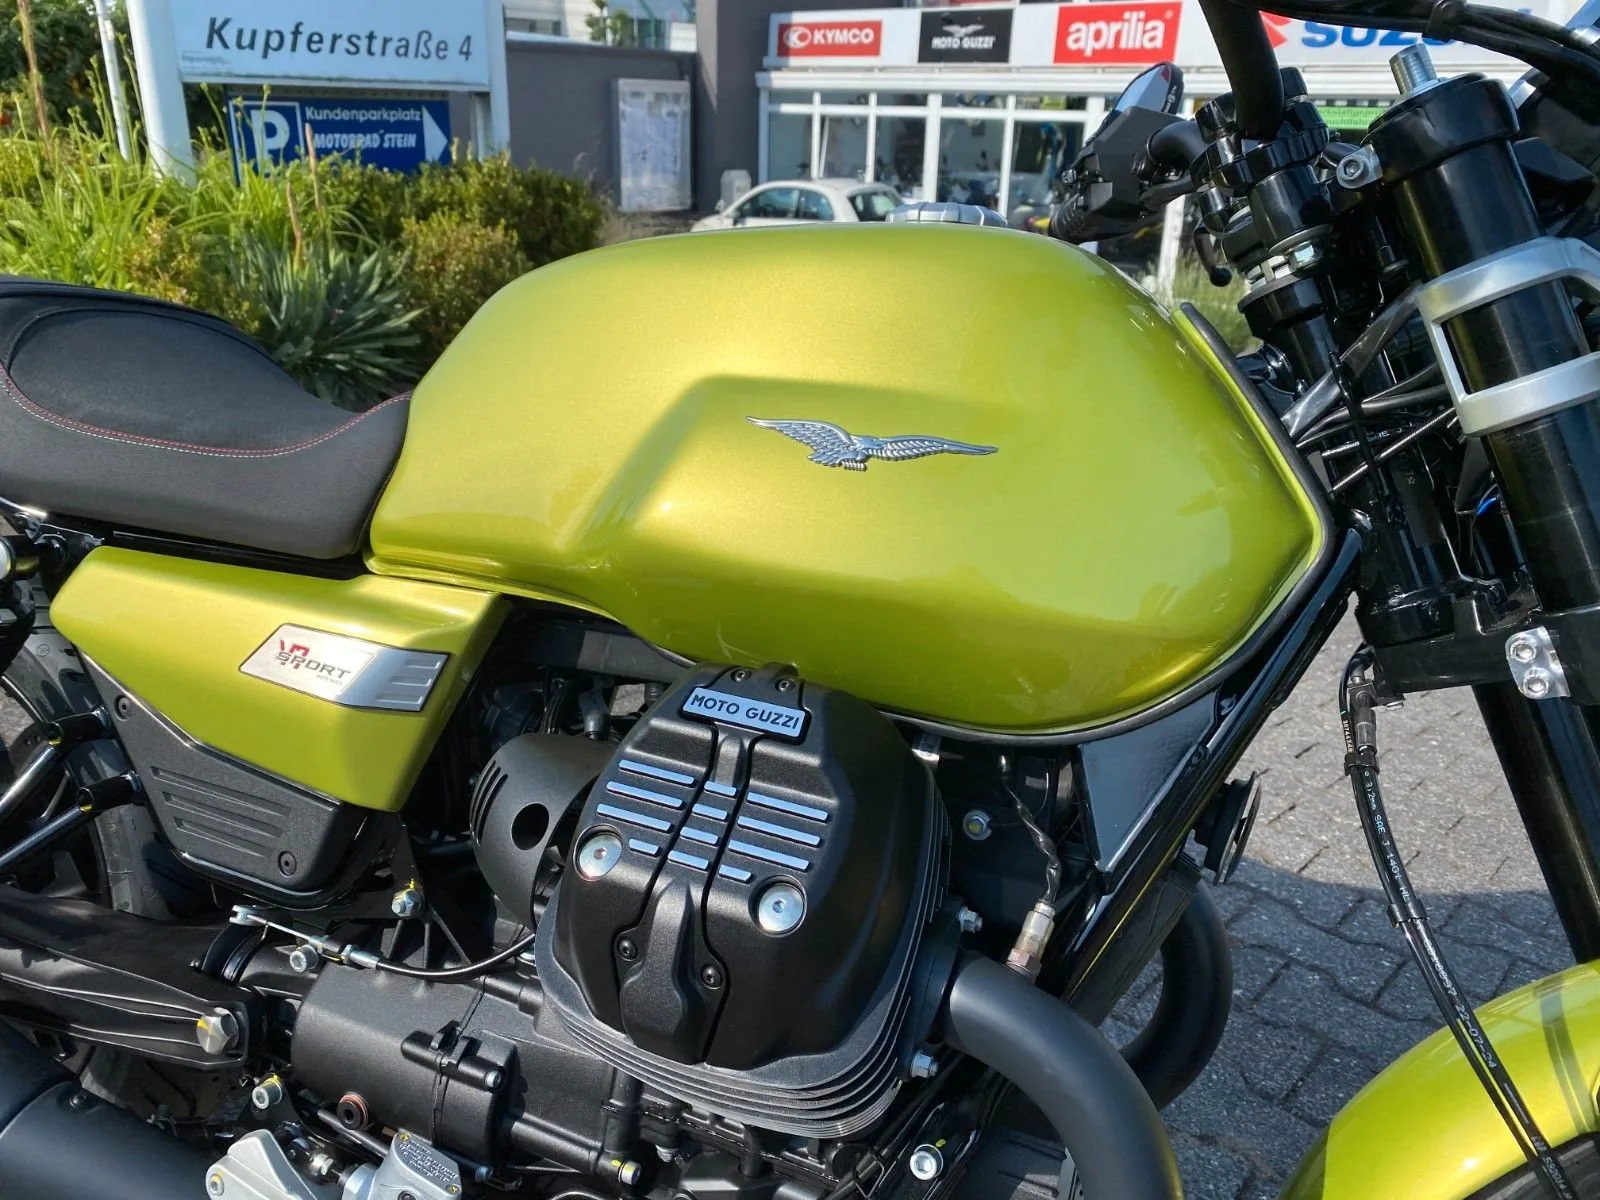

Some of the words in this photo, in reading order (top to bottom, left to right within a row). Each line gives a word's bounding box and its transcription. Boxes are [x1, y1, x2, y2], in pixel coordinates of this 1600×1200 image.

[206, 17, 448, 60] Kupferstraße
[459, 35, 472, 61] 4
[812, 27, 874, 45] KYMCO
[931, 36, 960, 49] MOTO
[961, 35, 994, 49] GUZZI
[1066, 10, 1165, 57] aprilia
[305, 106, 422, 123] Kundenparkplatz
[276, 651, 351, 679] SPORT
[690, 694, 740, 715] MOTO
[745, 707, 800, 730] GUZZI
[1374, 814, 1386, 835] SAE
